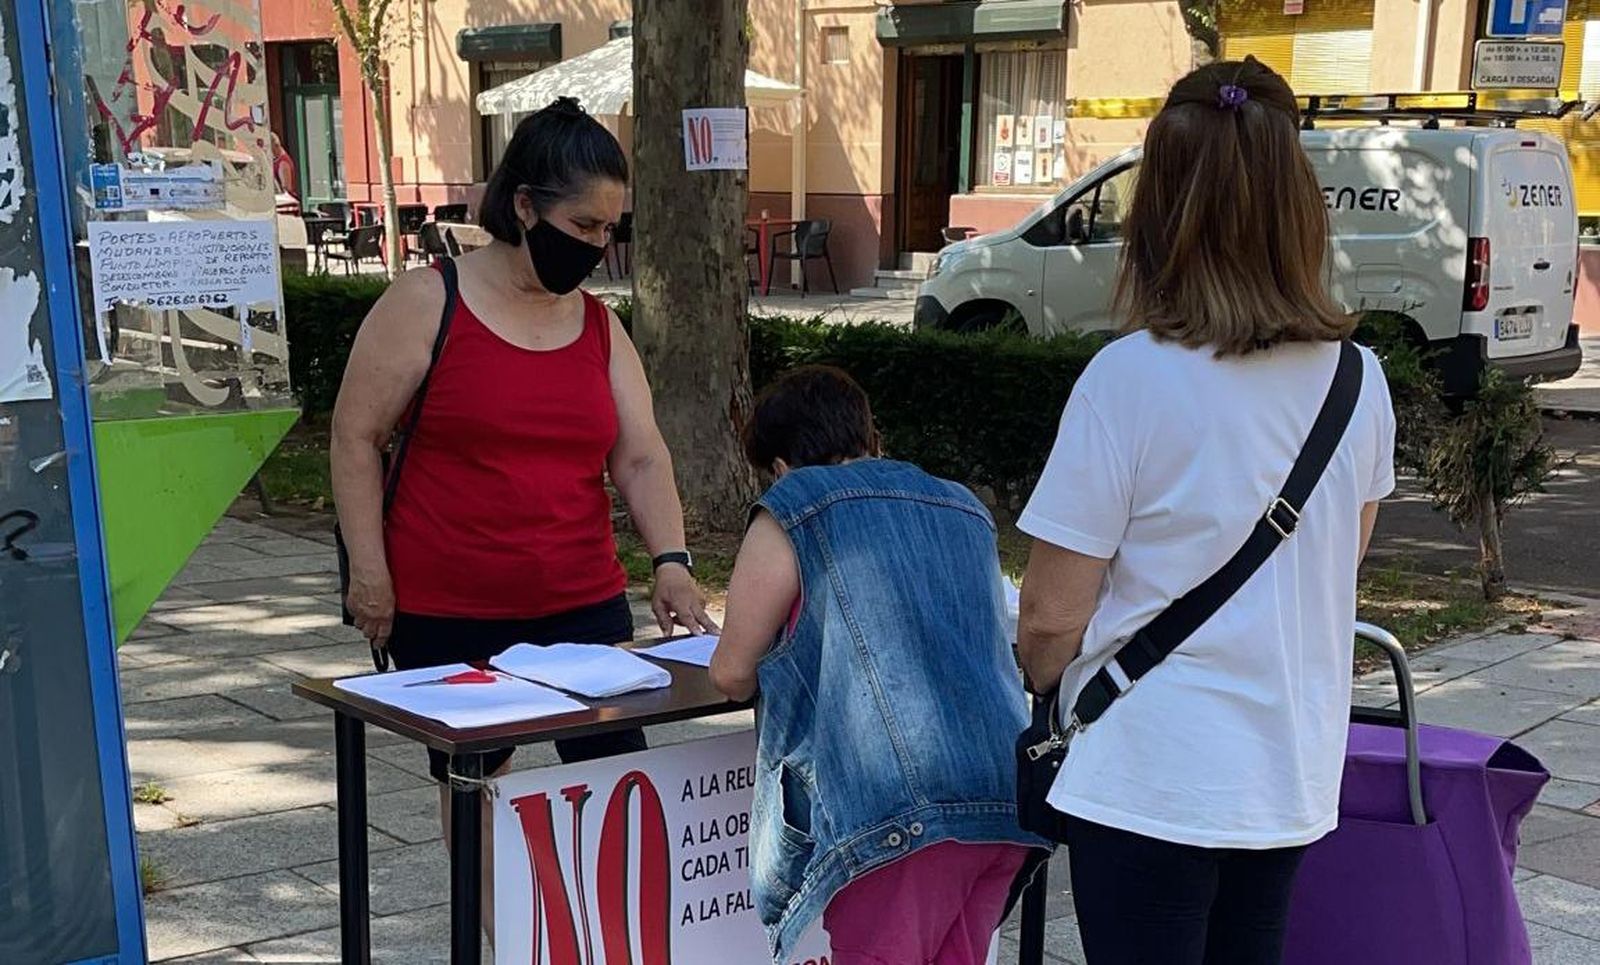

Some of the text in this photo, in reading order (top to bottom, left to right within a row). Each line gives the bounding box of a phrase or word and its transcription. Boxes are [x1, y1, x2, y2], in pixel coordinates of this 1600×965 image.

[1480, 75, 1507, 84] CARGA
[1517, 75, 1555, 84] DESCARGA
[688, 116, 712, 165] NO
[1520, 185, 1562, 207] ZENER
[99, 231, 157, 246] PORTES
[681, 764, 756, 802] A LA REU
[681, 812, 749, 848] A LA OB
[509, 770, 671, 965] NO
[681, 851, 730, 882] CADA
[681, 889, 755, 926] A LA FAL
